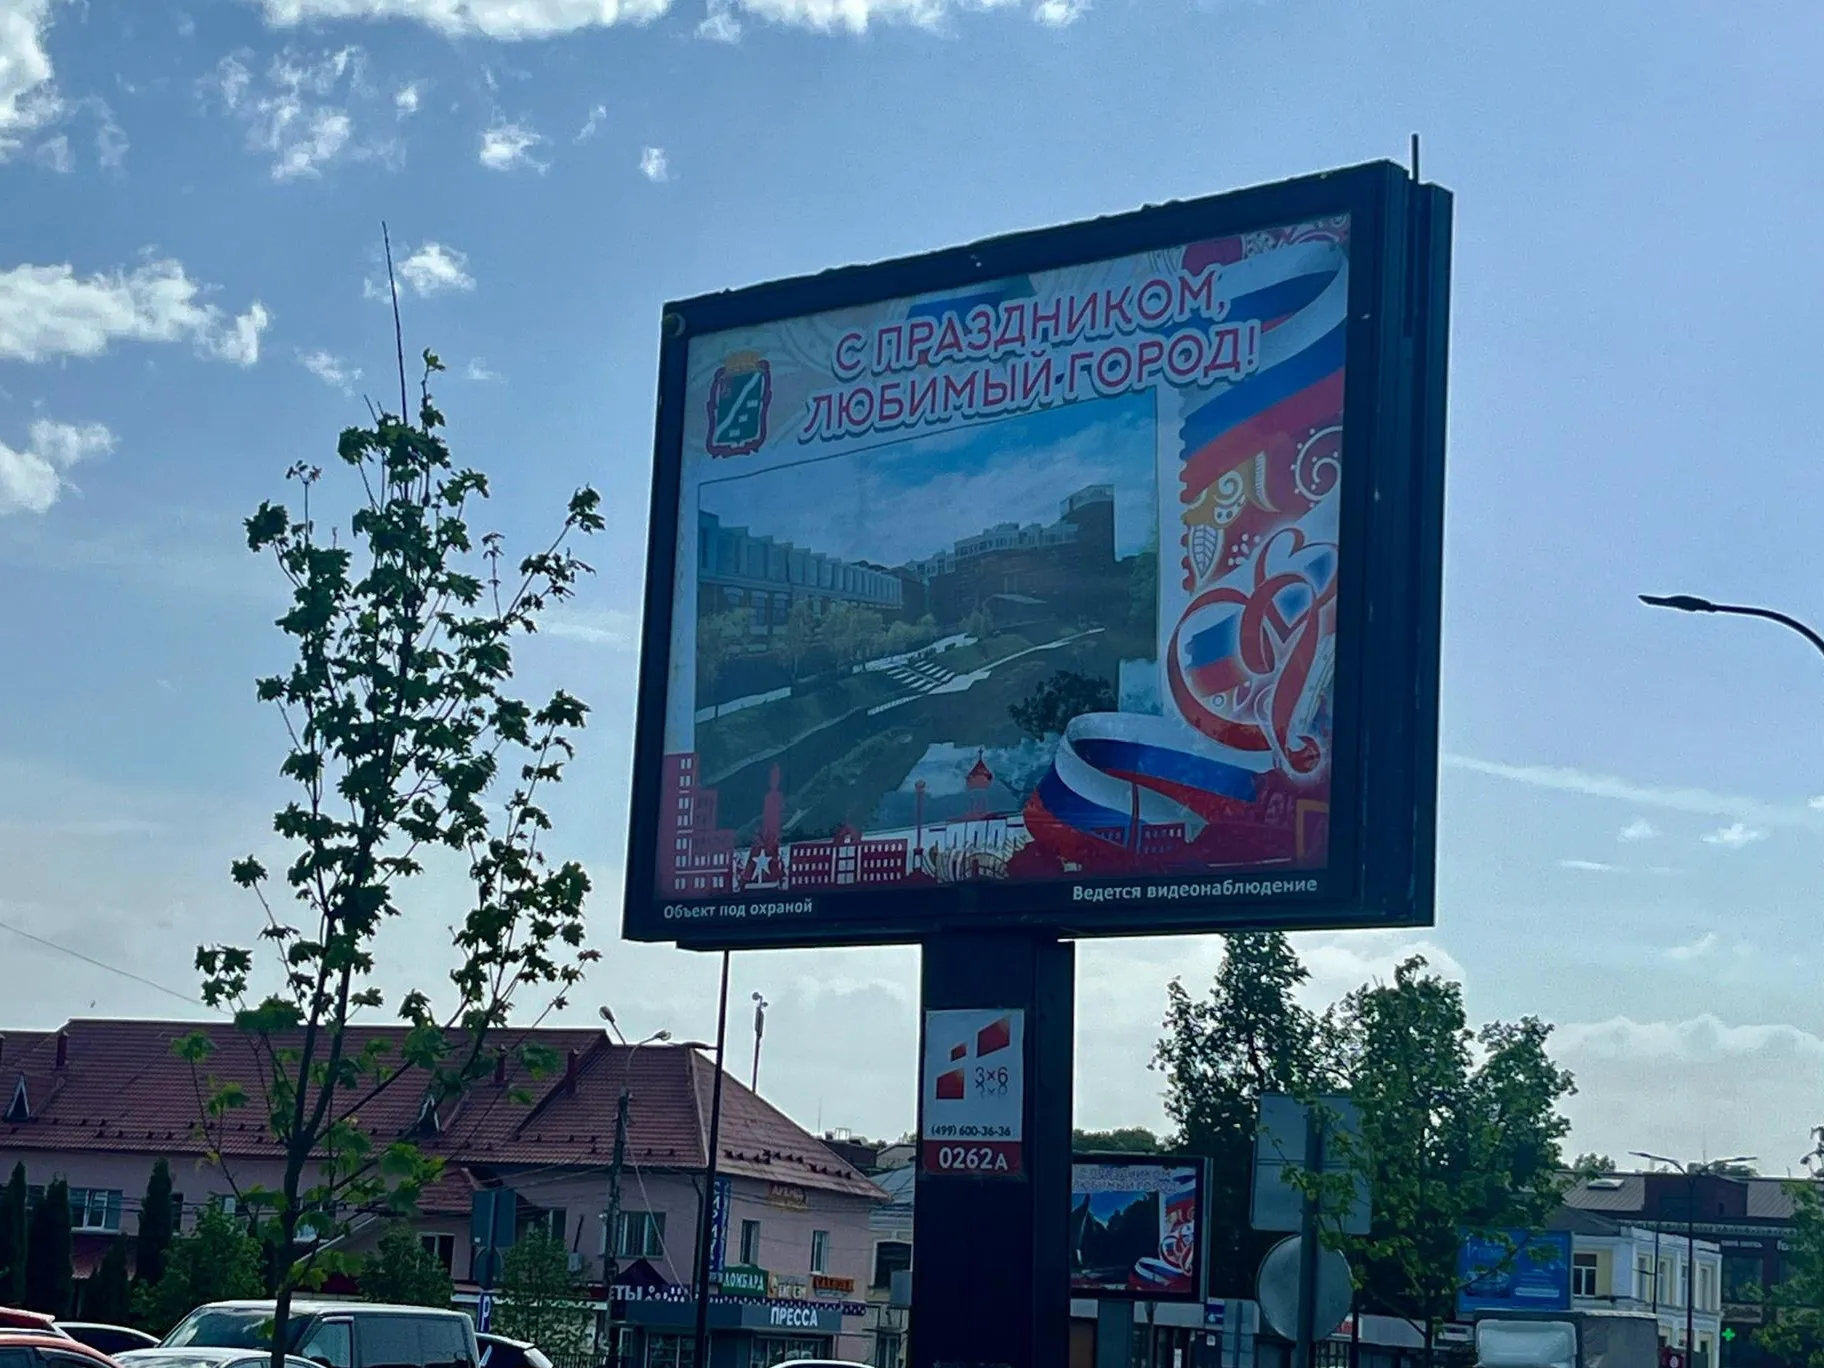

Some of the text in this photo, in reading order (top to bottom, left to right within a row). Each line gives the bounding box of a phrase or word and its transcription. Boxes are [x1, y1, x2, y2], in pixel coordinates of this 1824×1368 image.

[835, 271, 1227, 372] С ПРАЗДНИКОМ,
[803, 325, 1256, 432] ЛЮБИМЫЙ ГОРОД!
[1073, 878, 1318, 902] Ведется видеонаблюдение
[663, 898, 813, 919] Объект под охраной
[931, 1124, 1012, 1137] (499) 600-36-36
[723, 1272, 764, 1291] ЛОМБАРД
[770, 1306, 818, 1327] ПРЕССА
